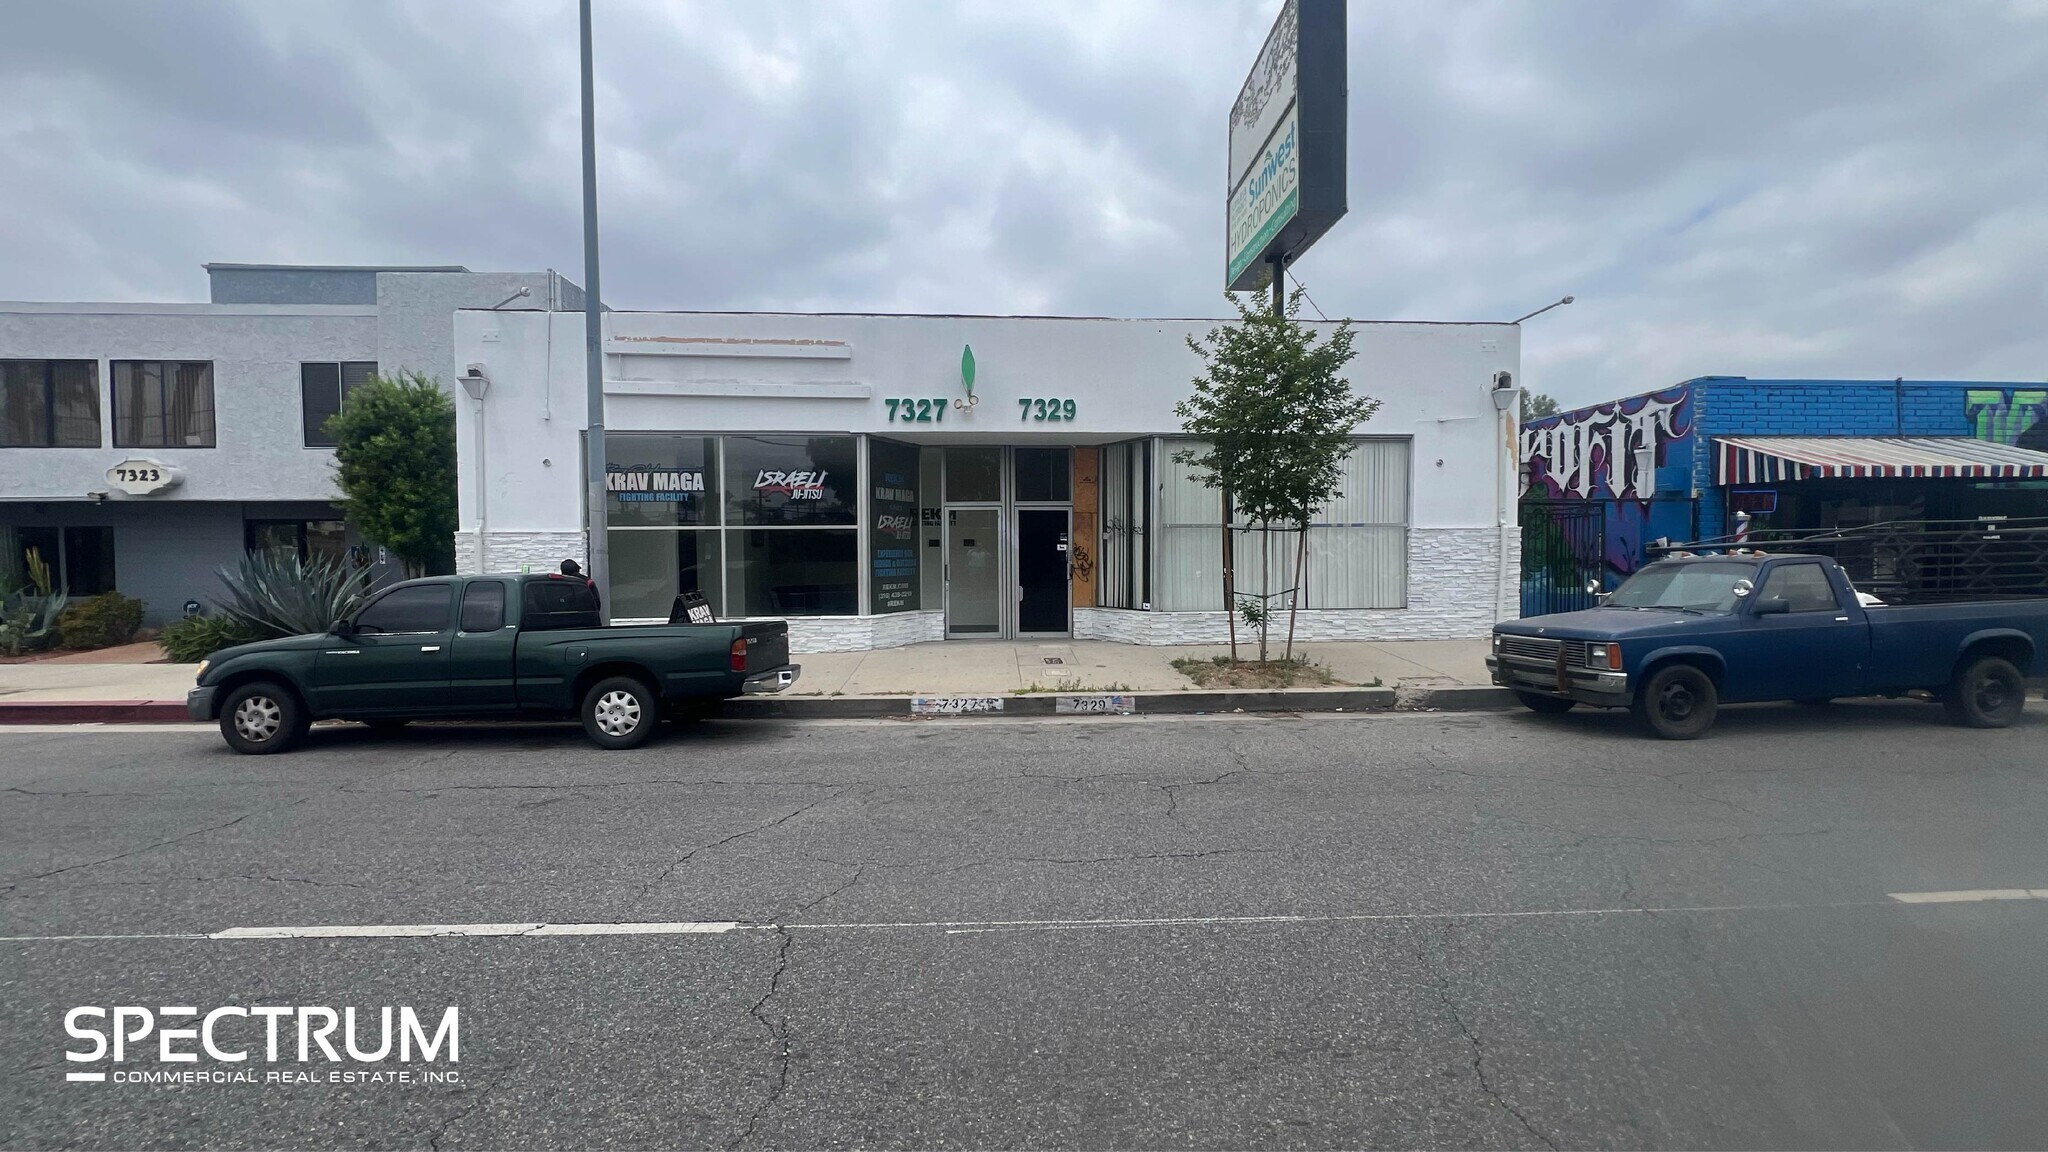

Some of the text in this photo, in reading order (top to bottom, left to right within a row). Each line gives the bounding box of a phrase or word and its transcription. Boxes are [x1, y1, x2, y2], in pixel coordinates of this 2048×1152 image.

[1249, 121, 1296, 207] Sunwest
[1231, 157, 1296, 253] HYDROPONICS
[885, 398, 948, 422] 7327
[1018, 398, 1077, 422] 7329
[116, 469, 160, 482] 7323
[606, 472, 705, 491] KRAV MAGA
[753, 469, 828, 489] ISRAELI
[619, 492, 689, 502] FIGHTING FACILITY
[791, 489, 823, 500] JU-JITSU
[875, 486, 914, 503] KRAV MAGA
[878, 514, 913, 530] ISRAELI
[687, 604, 710, 621] KRAV
[1073, 699, 1106, 711] 7329
